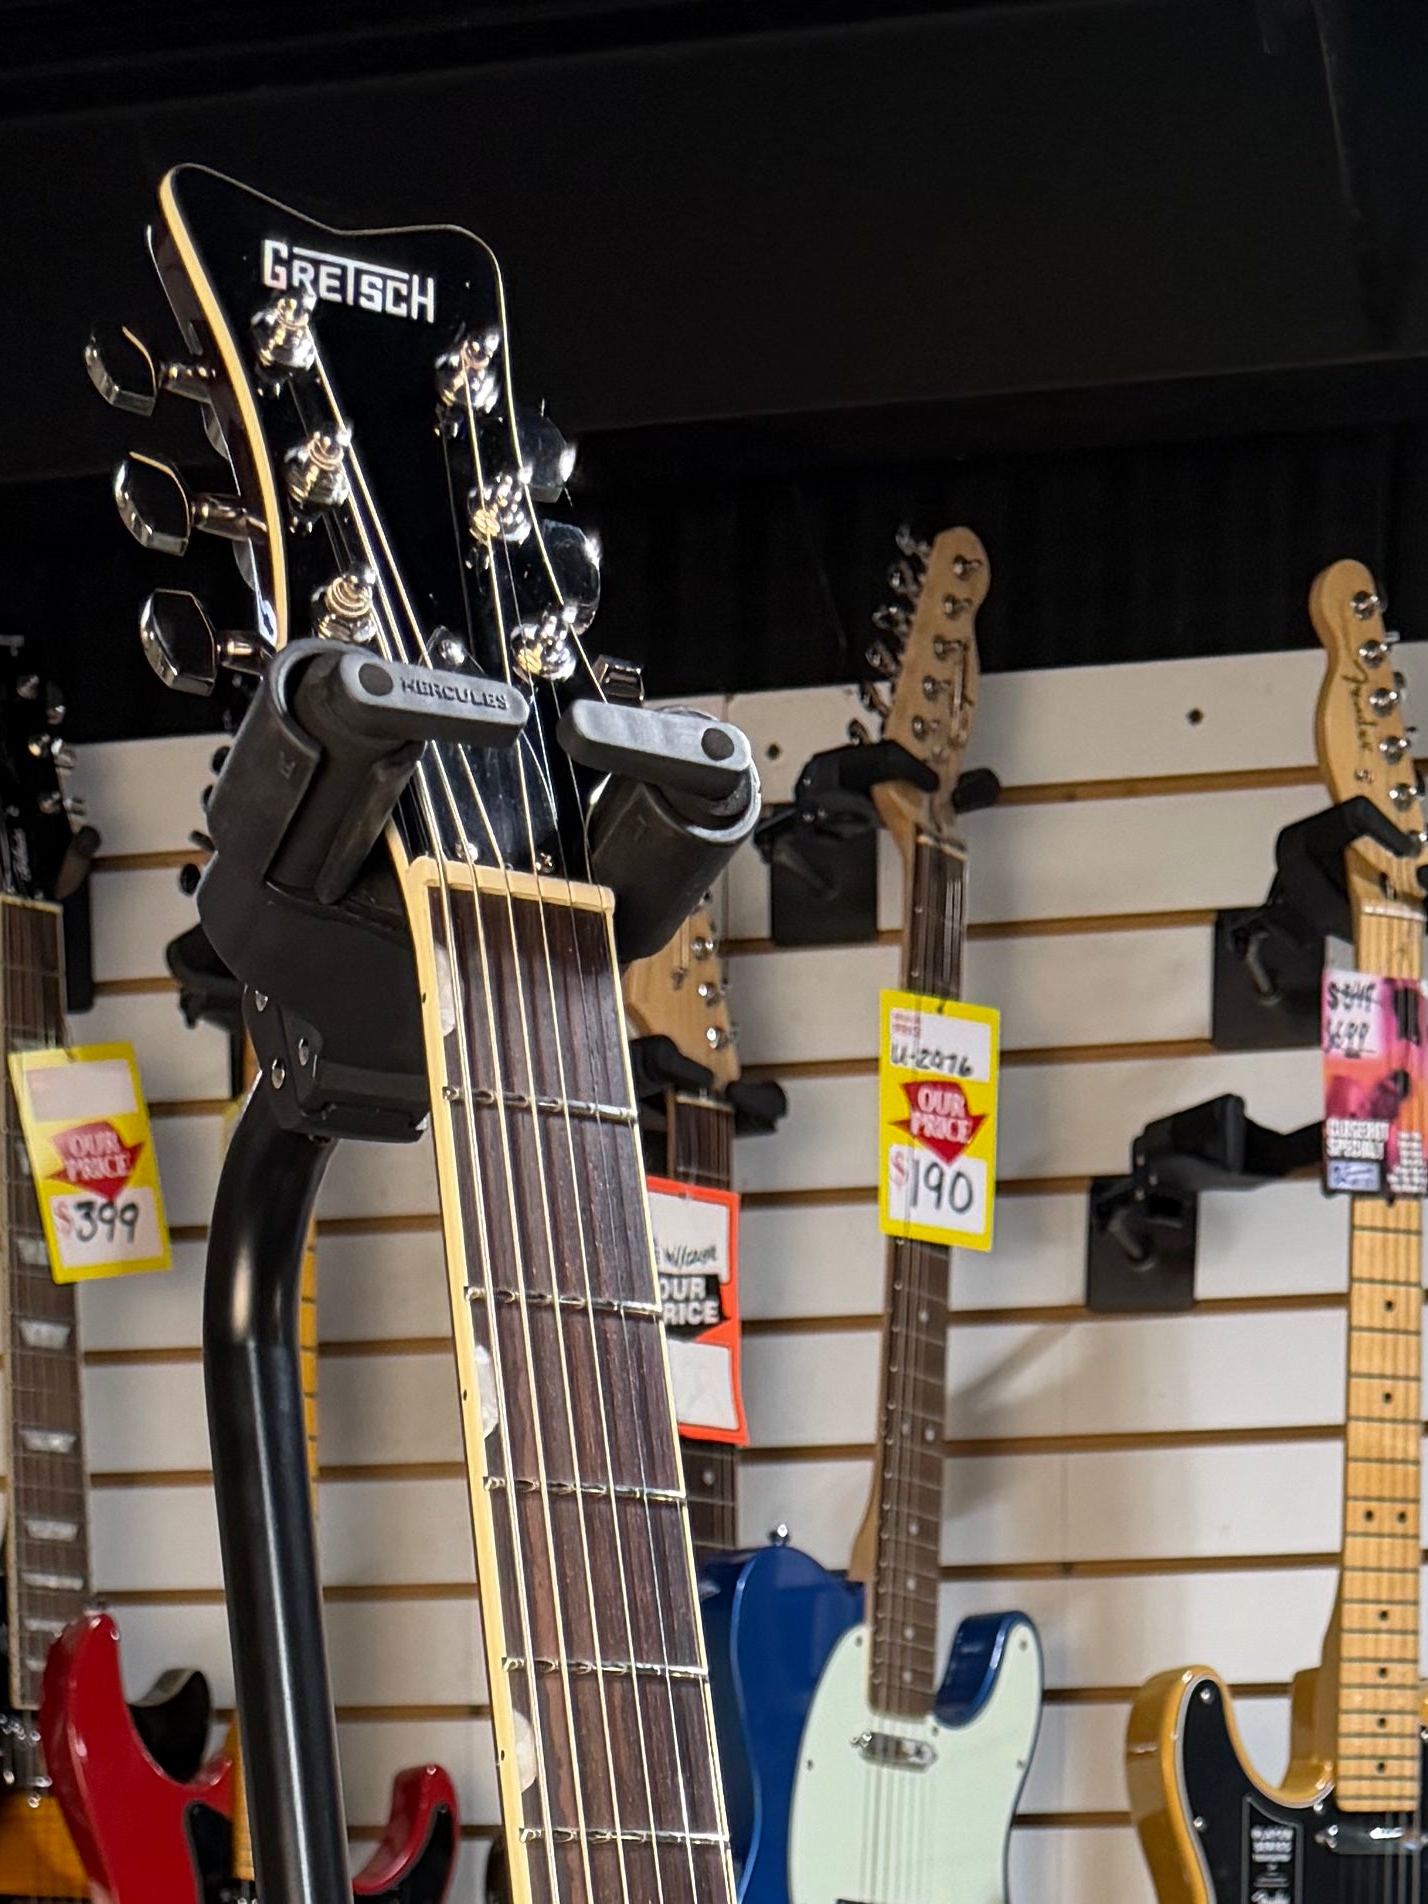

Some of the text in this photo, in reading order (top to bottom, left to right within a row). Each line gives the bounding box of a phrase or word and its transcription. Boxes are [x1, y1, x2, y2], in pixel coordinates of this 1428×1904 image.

[261, 239, 436, 324] GRETSCH
[400, 677, 508, 710] HERCULES
[917, 1084, 966, 1118] OUR
[71, 1131, 121, 1155] OUR
[910, 1111, 973, 1144] PRICE
[65, 1152, 131, 1182] PRICE
[662, 1302, 720, 1325] RICE
